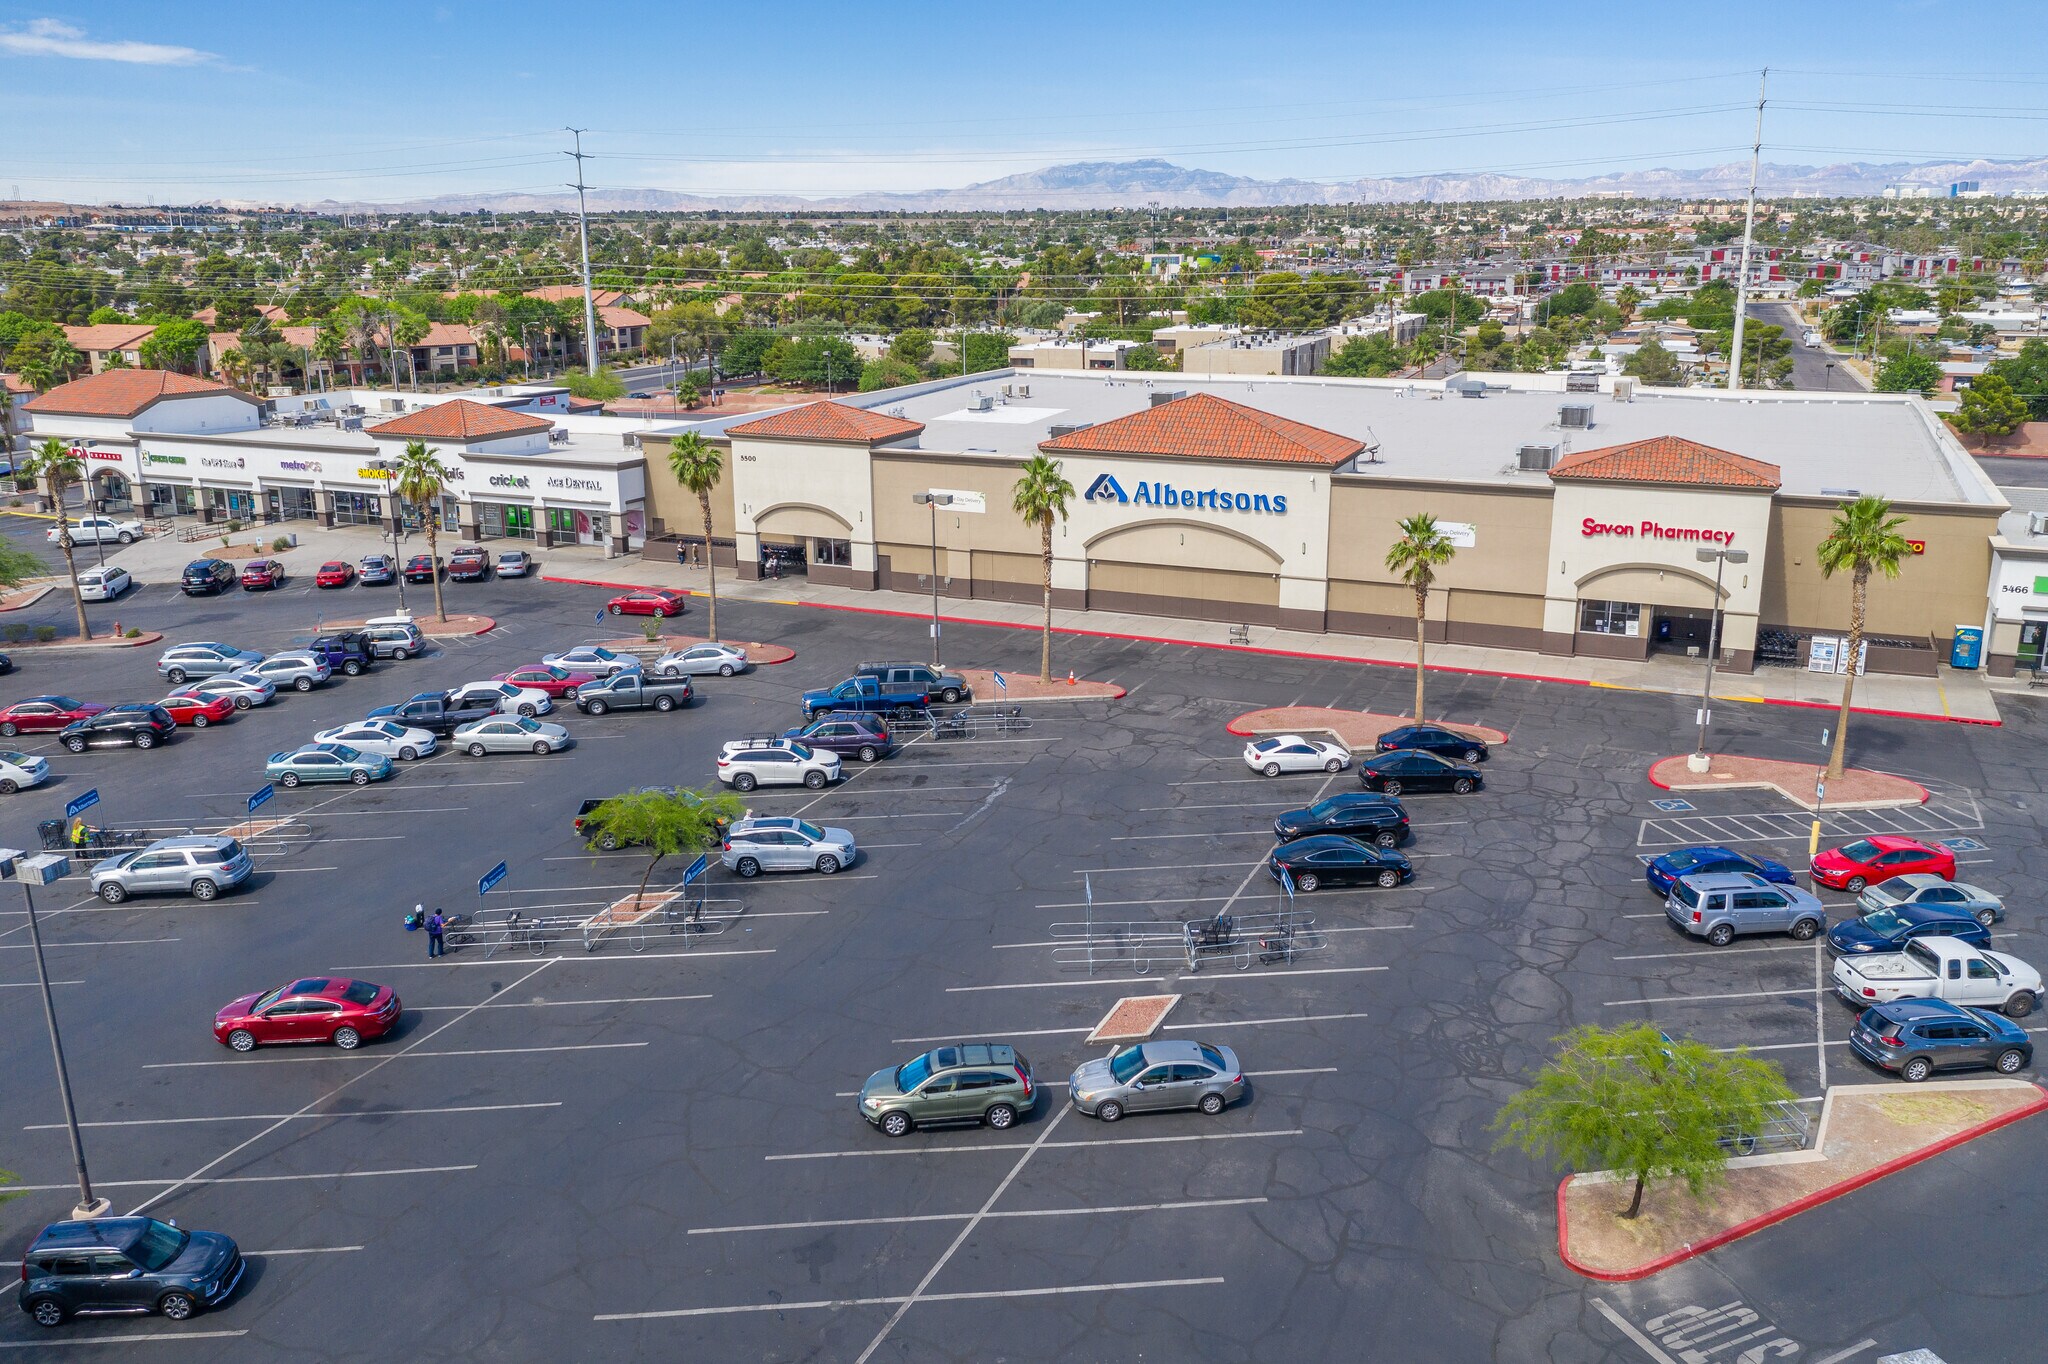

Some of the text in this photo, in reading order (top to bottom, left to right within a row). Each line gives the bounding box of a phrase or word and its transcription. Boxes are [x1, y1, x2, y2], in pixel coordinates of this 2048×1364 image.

[489, 474, 530, 488] cricket
[1133, 481, 1288, 513] Albertsons
[1640, 520, 1735, 546] Pharmacy
[2002, 585, 2029, 594] 5466
